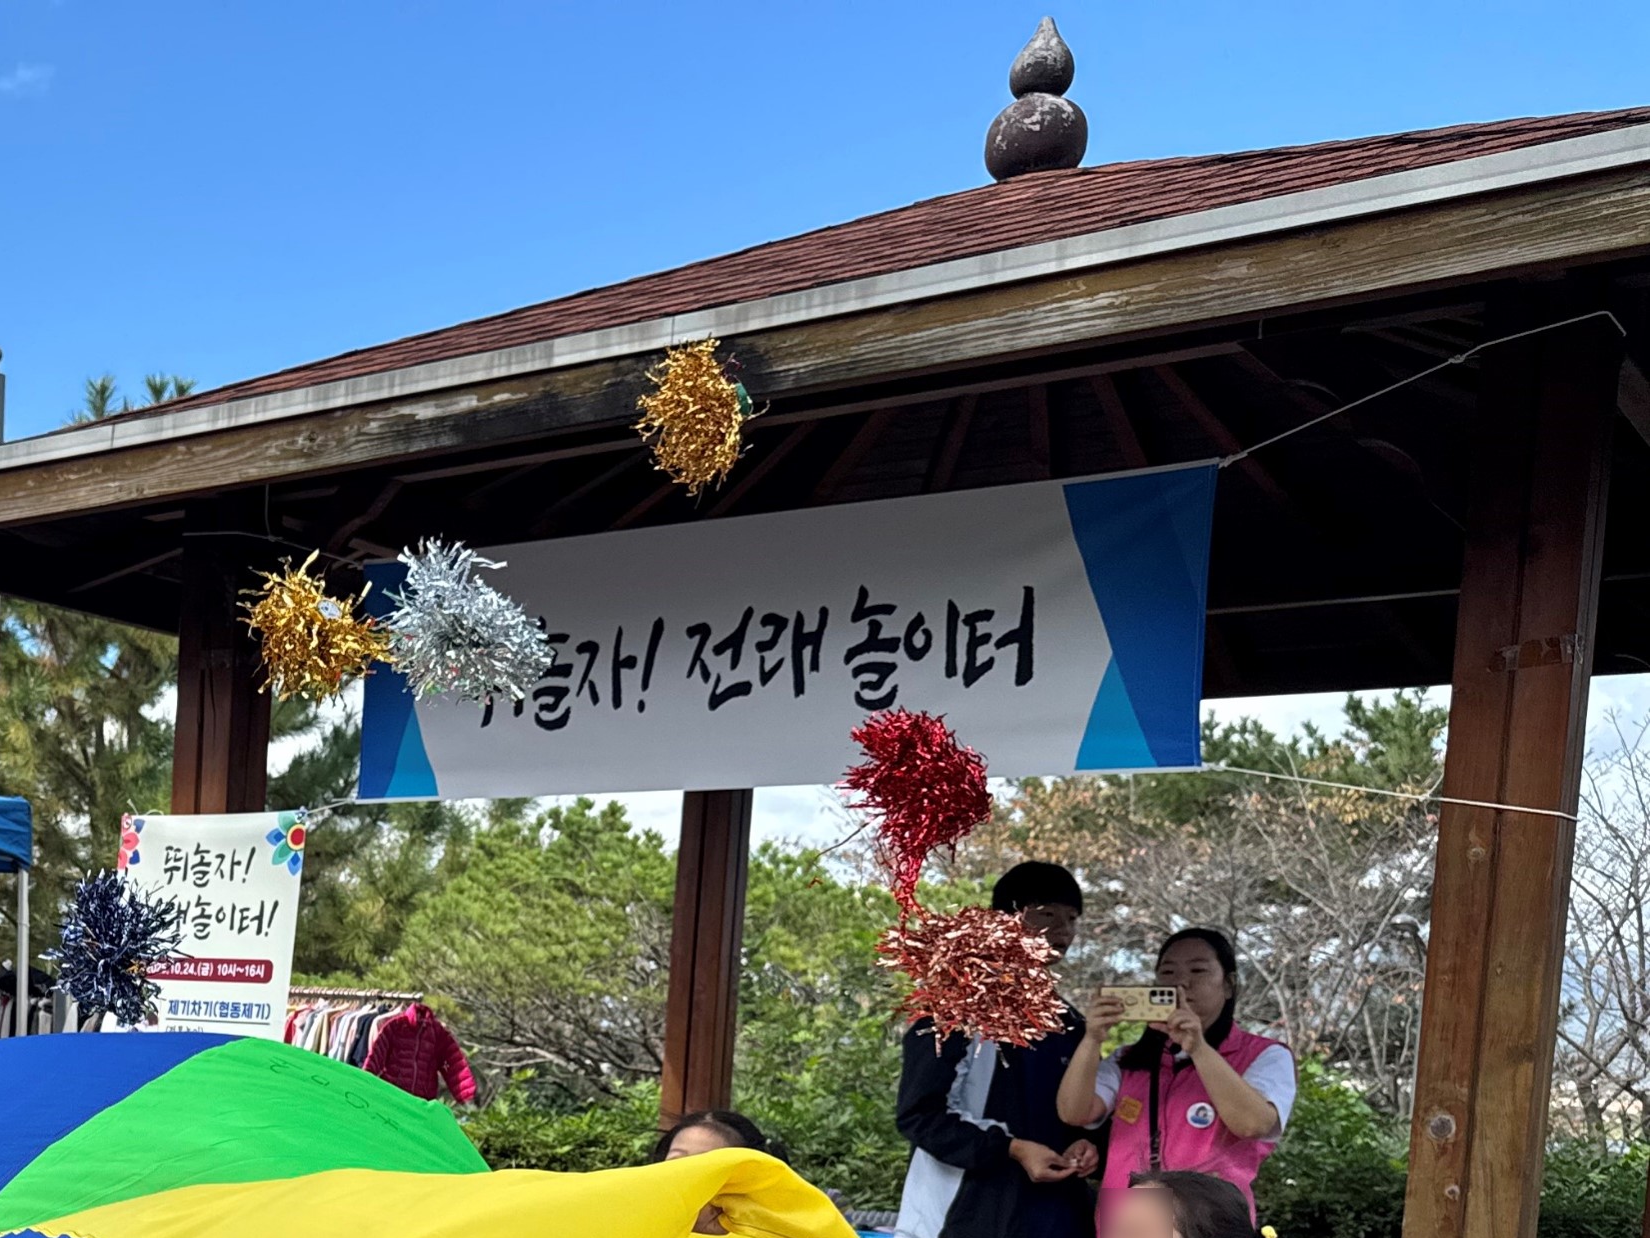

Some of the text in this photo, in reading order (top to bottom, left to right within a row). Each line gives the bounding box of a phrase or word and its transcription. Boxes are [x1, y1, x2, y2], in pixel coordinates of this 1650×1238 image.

[480, 585, 1035, 730] 놀자! 전래 놀이터
[163, 842, 256, 888] 뛰놀자!
[217, 962, 265, 978] 10시~16시
[167, 1000, 271, 1020] 제기차기(협동제기)
